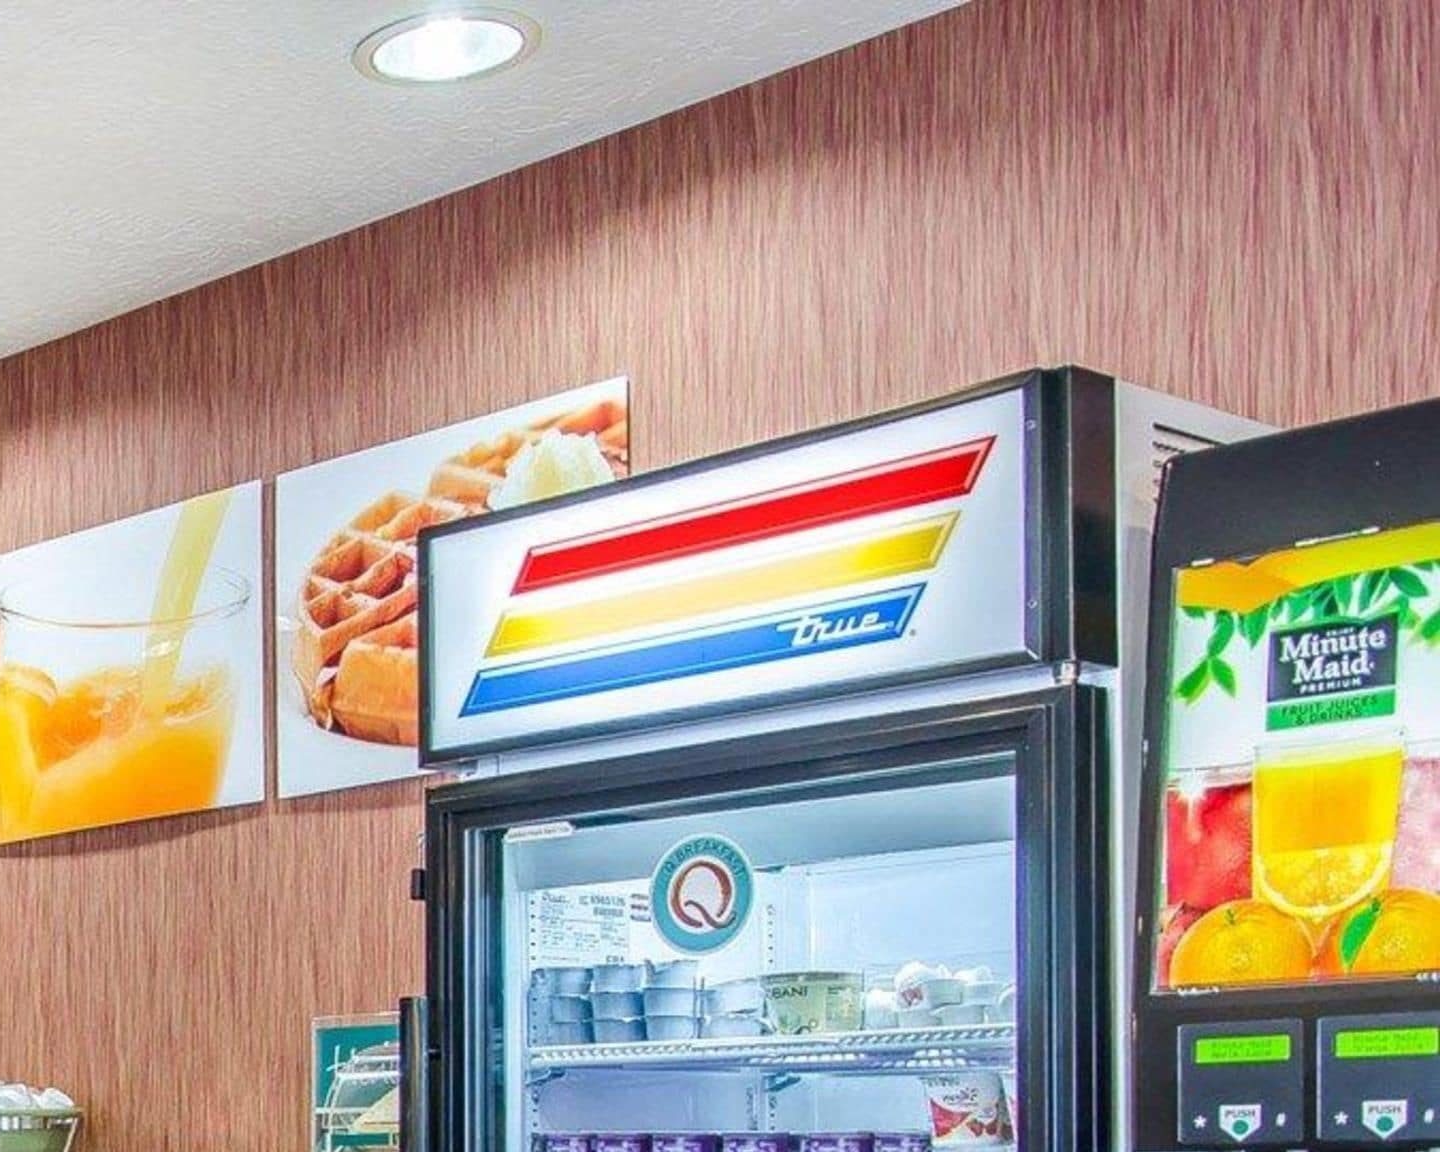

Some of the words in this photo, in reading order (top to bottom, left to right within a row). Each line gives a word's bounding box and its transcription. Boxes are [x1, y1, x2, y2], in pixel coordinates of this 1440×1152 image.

[1279, 627, 1387, 662] Minute
[1292, 650, 1371, 684] Maid
[1299, 677, 1363, 694] PREMIUM
